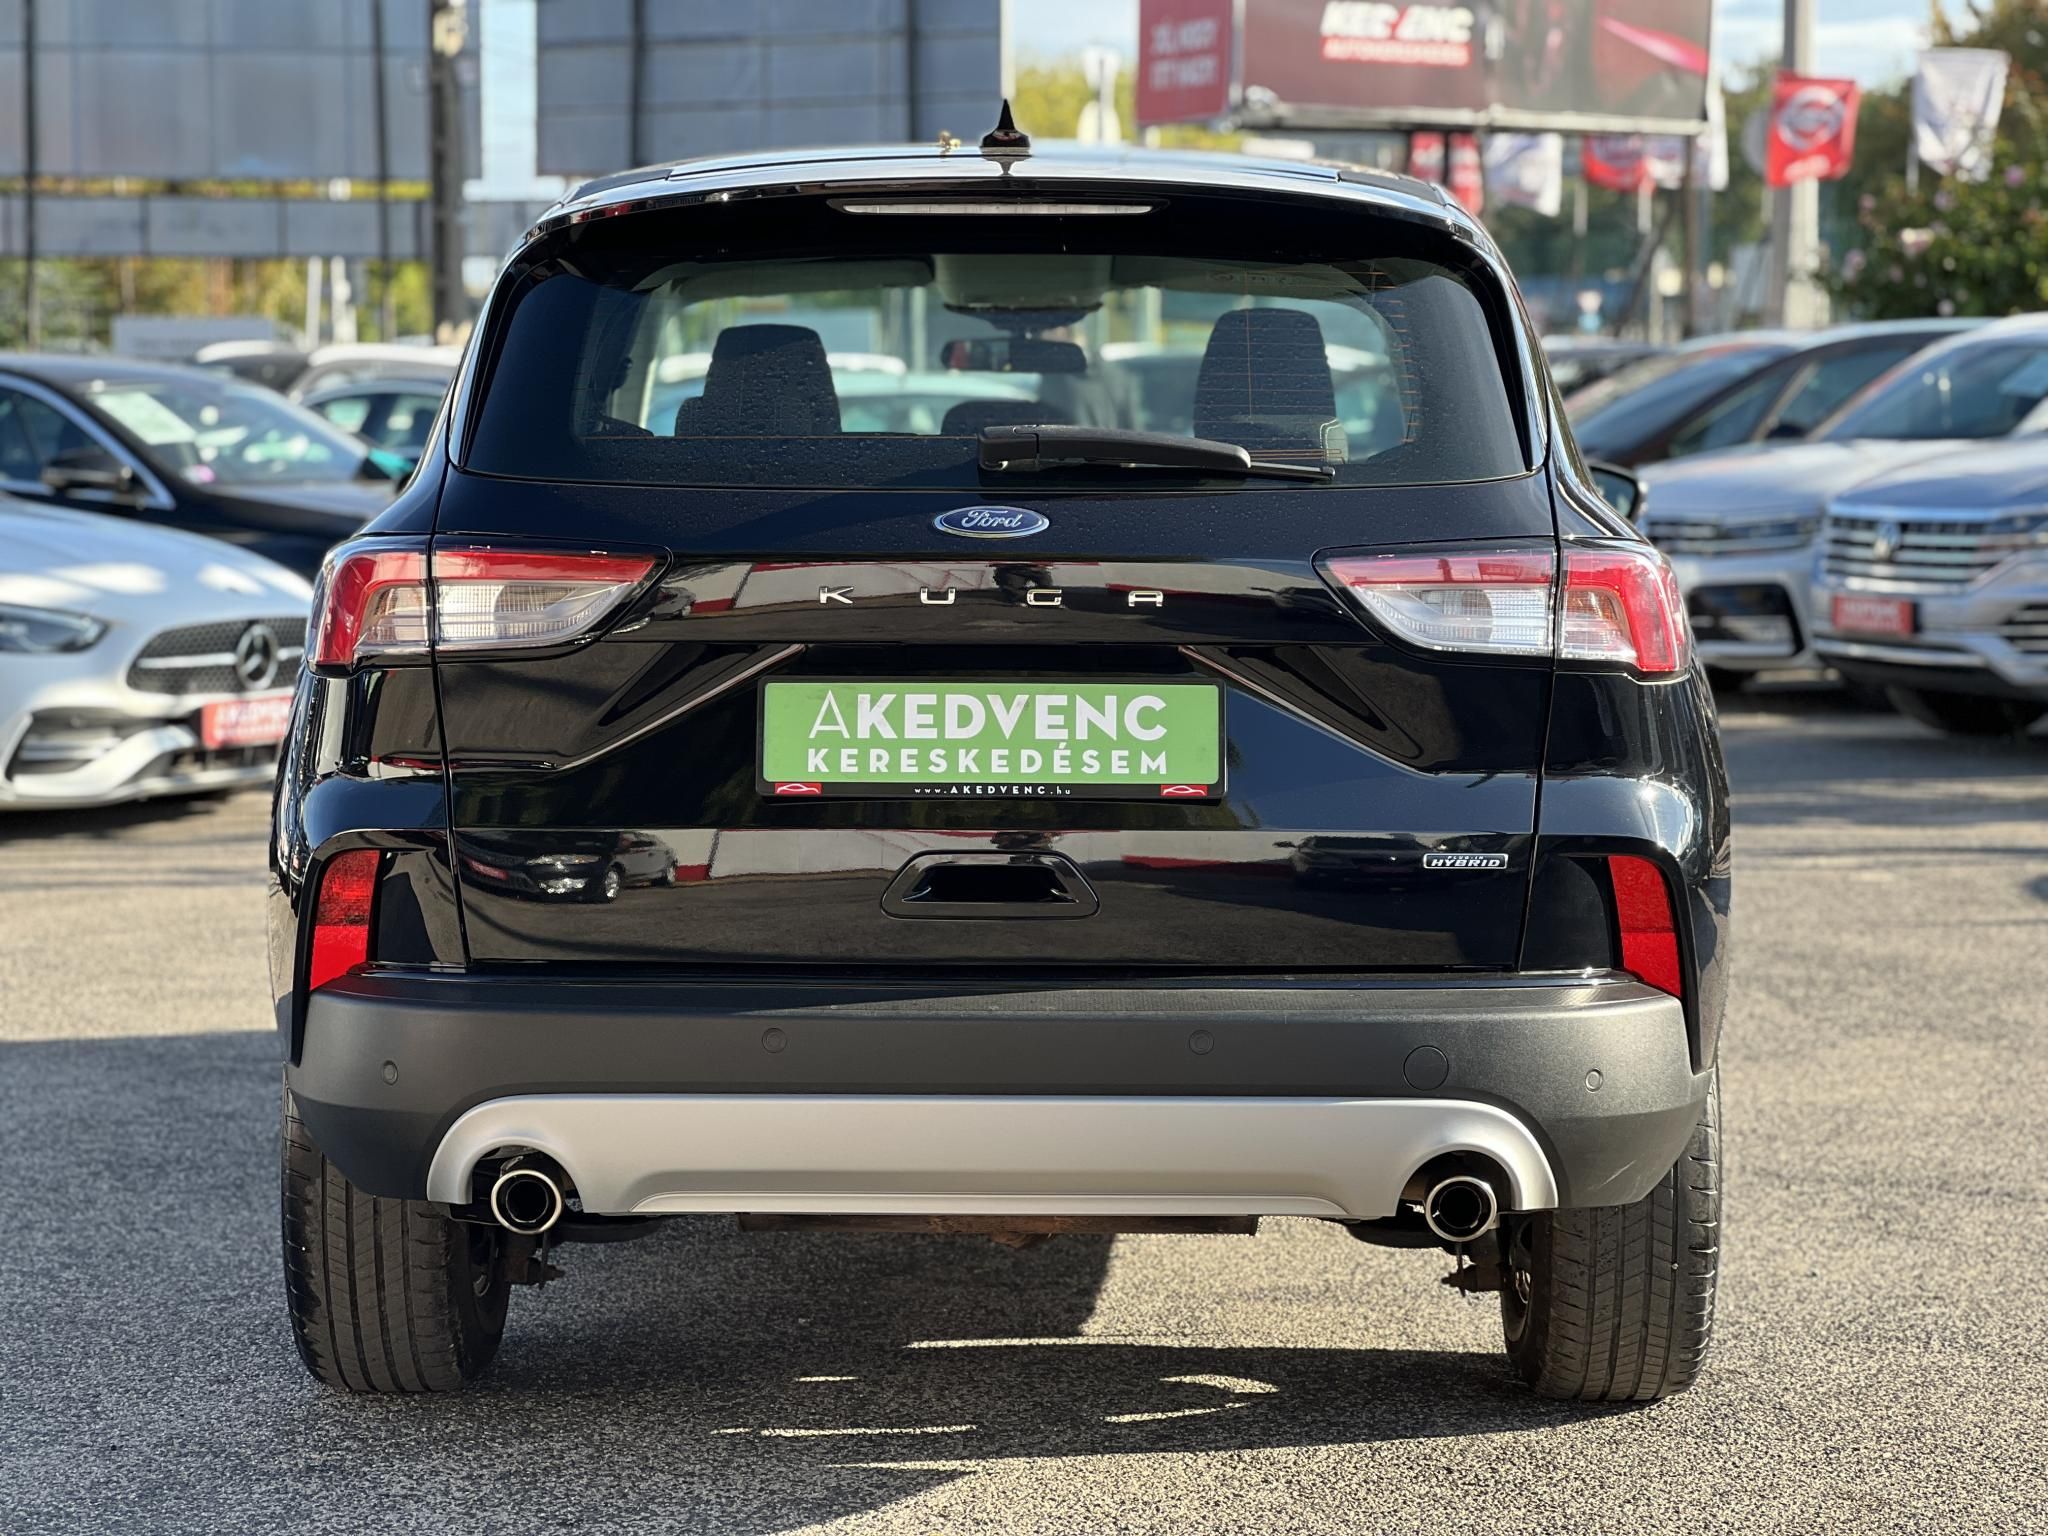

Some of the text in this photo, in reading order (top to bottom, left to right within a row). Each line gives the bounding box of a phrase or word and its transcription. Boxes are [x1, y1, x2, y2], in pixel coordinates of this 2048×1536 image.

[961, 509, 1023, 528] Ford
[819, 586, 1164, 607] KUGA
[807, 742, 1167, 775] KERESKEDÉSEM
[914, 785, 1071, 795] www.AKEDVENC.hu
[1431, 859, 1501, 867] HYBRID
